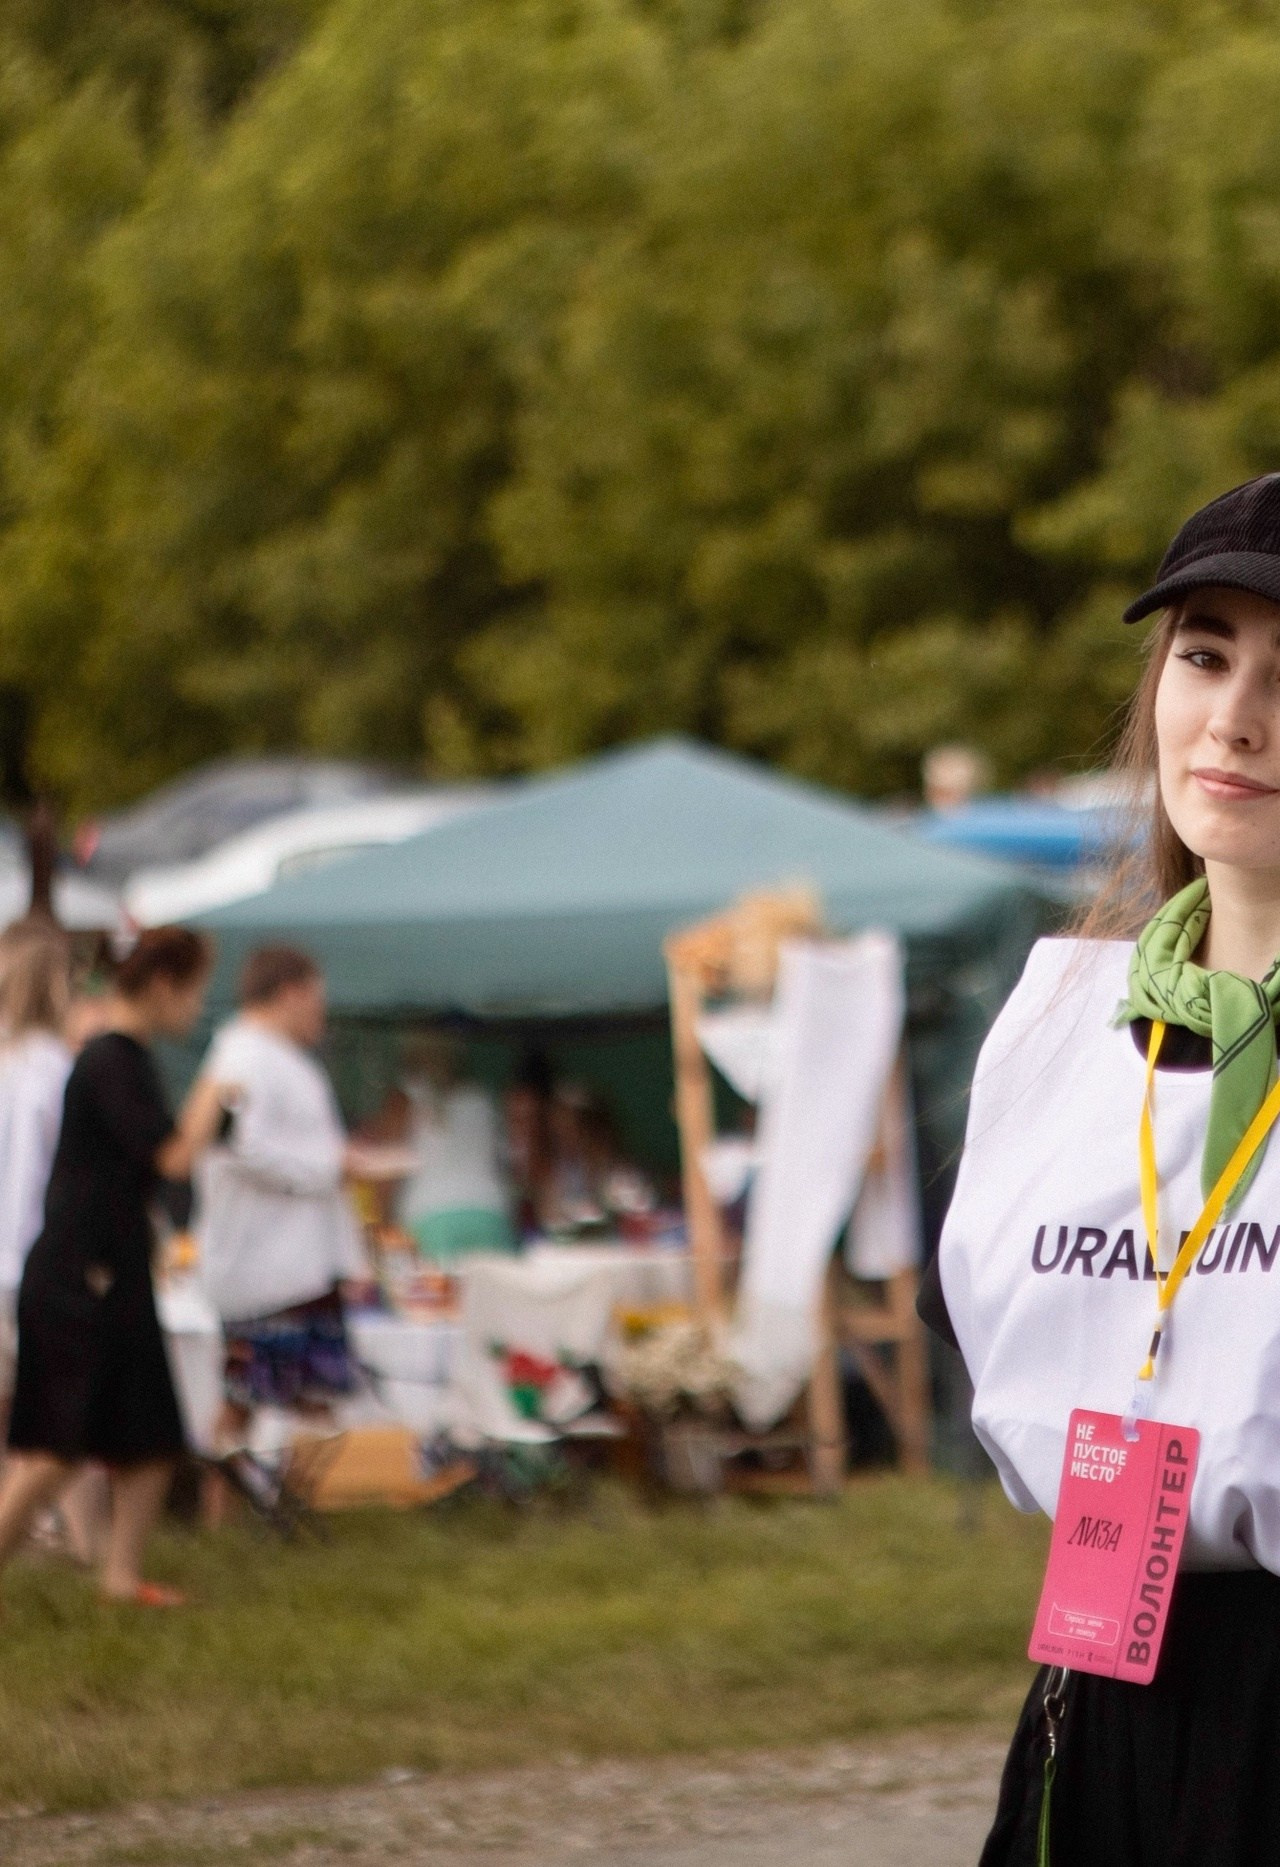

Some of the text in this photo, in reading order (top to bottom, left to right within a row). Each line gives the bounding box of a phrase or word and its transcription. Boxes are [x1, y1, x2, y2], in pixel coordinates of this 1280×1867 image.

[1076, 1423, 1096, 1441] НЕ
[1073, 1442, 1128, 1466] ПУСТОЕ
[1067, 1516, 1123, 1552] ЛИЗА
[1126, 1439, 1189, 1667] ВОЛОНТЕР
